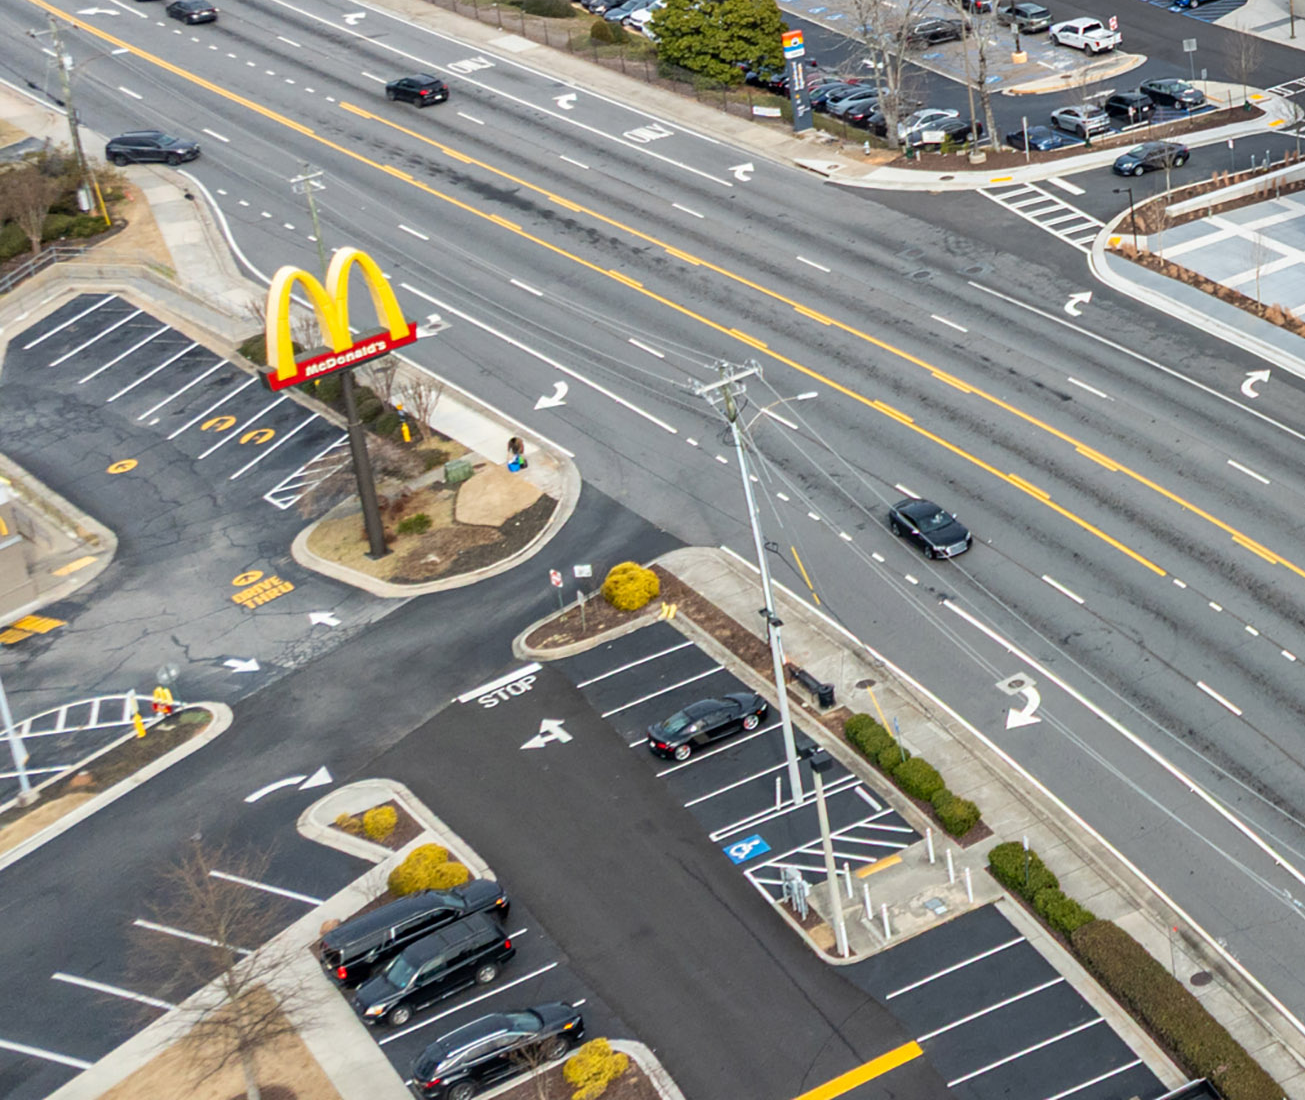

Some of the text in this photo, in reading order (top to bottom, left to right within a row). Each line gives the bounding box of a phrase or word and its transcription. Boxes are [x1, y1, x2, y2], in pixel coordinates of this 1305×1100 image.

[446, 56, 496, 74] ONLY
[622, 123, 674, 143] ONLY
[305, 340, 387, 377] McDonald's
[231, 575, 284, 604] DRIVE
[241, 581, 295, 609] THRU
[477, 675, 537, 708] STOP
